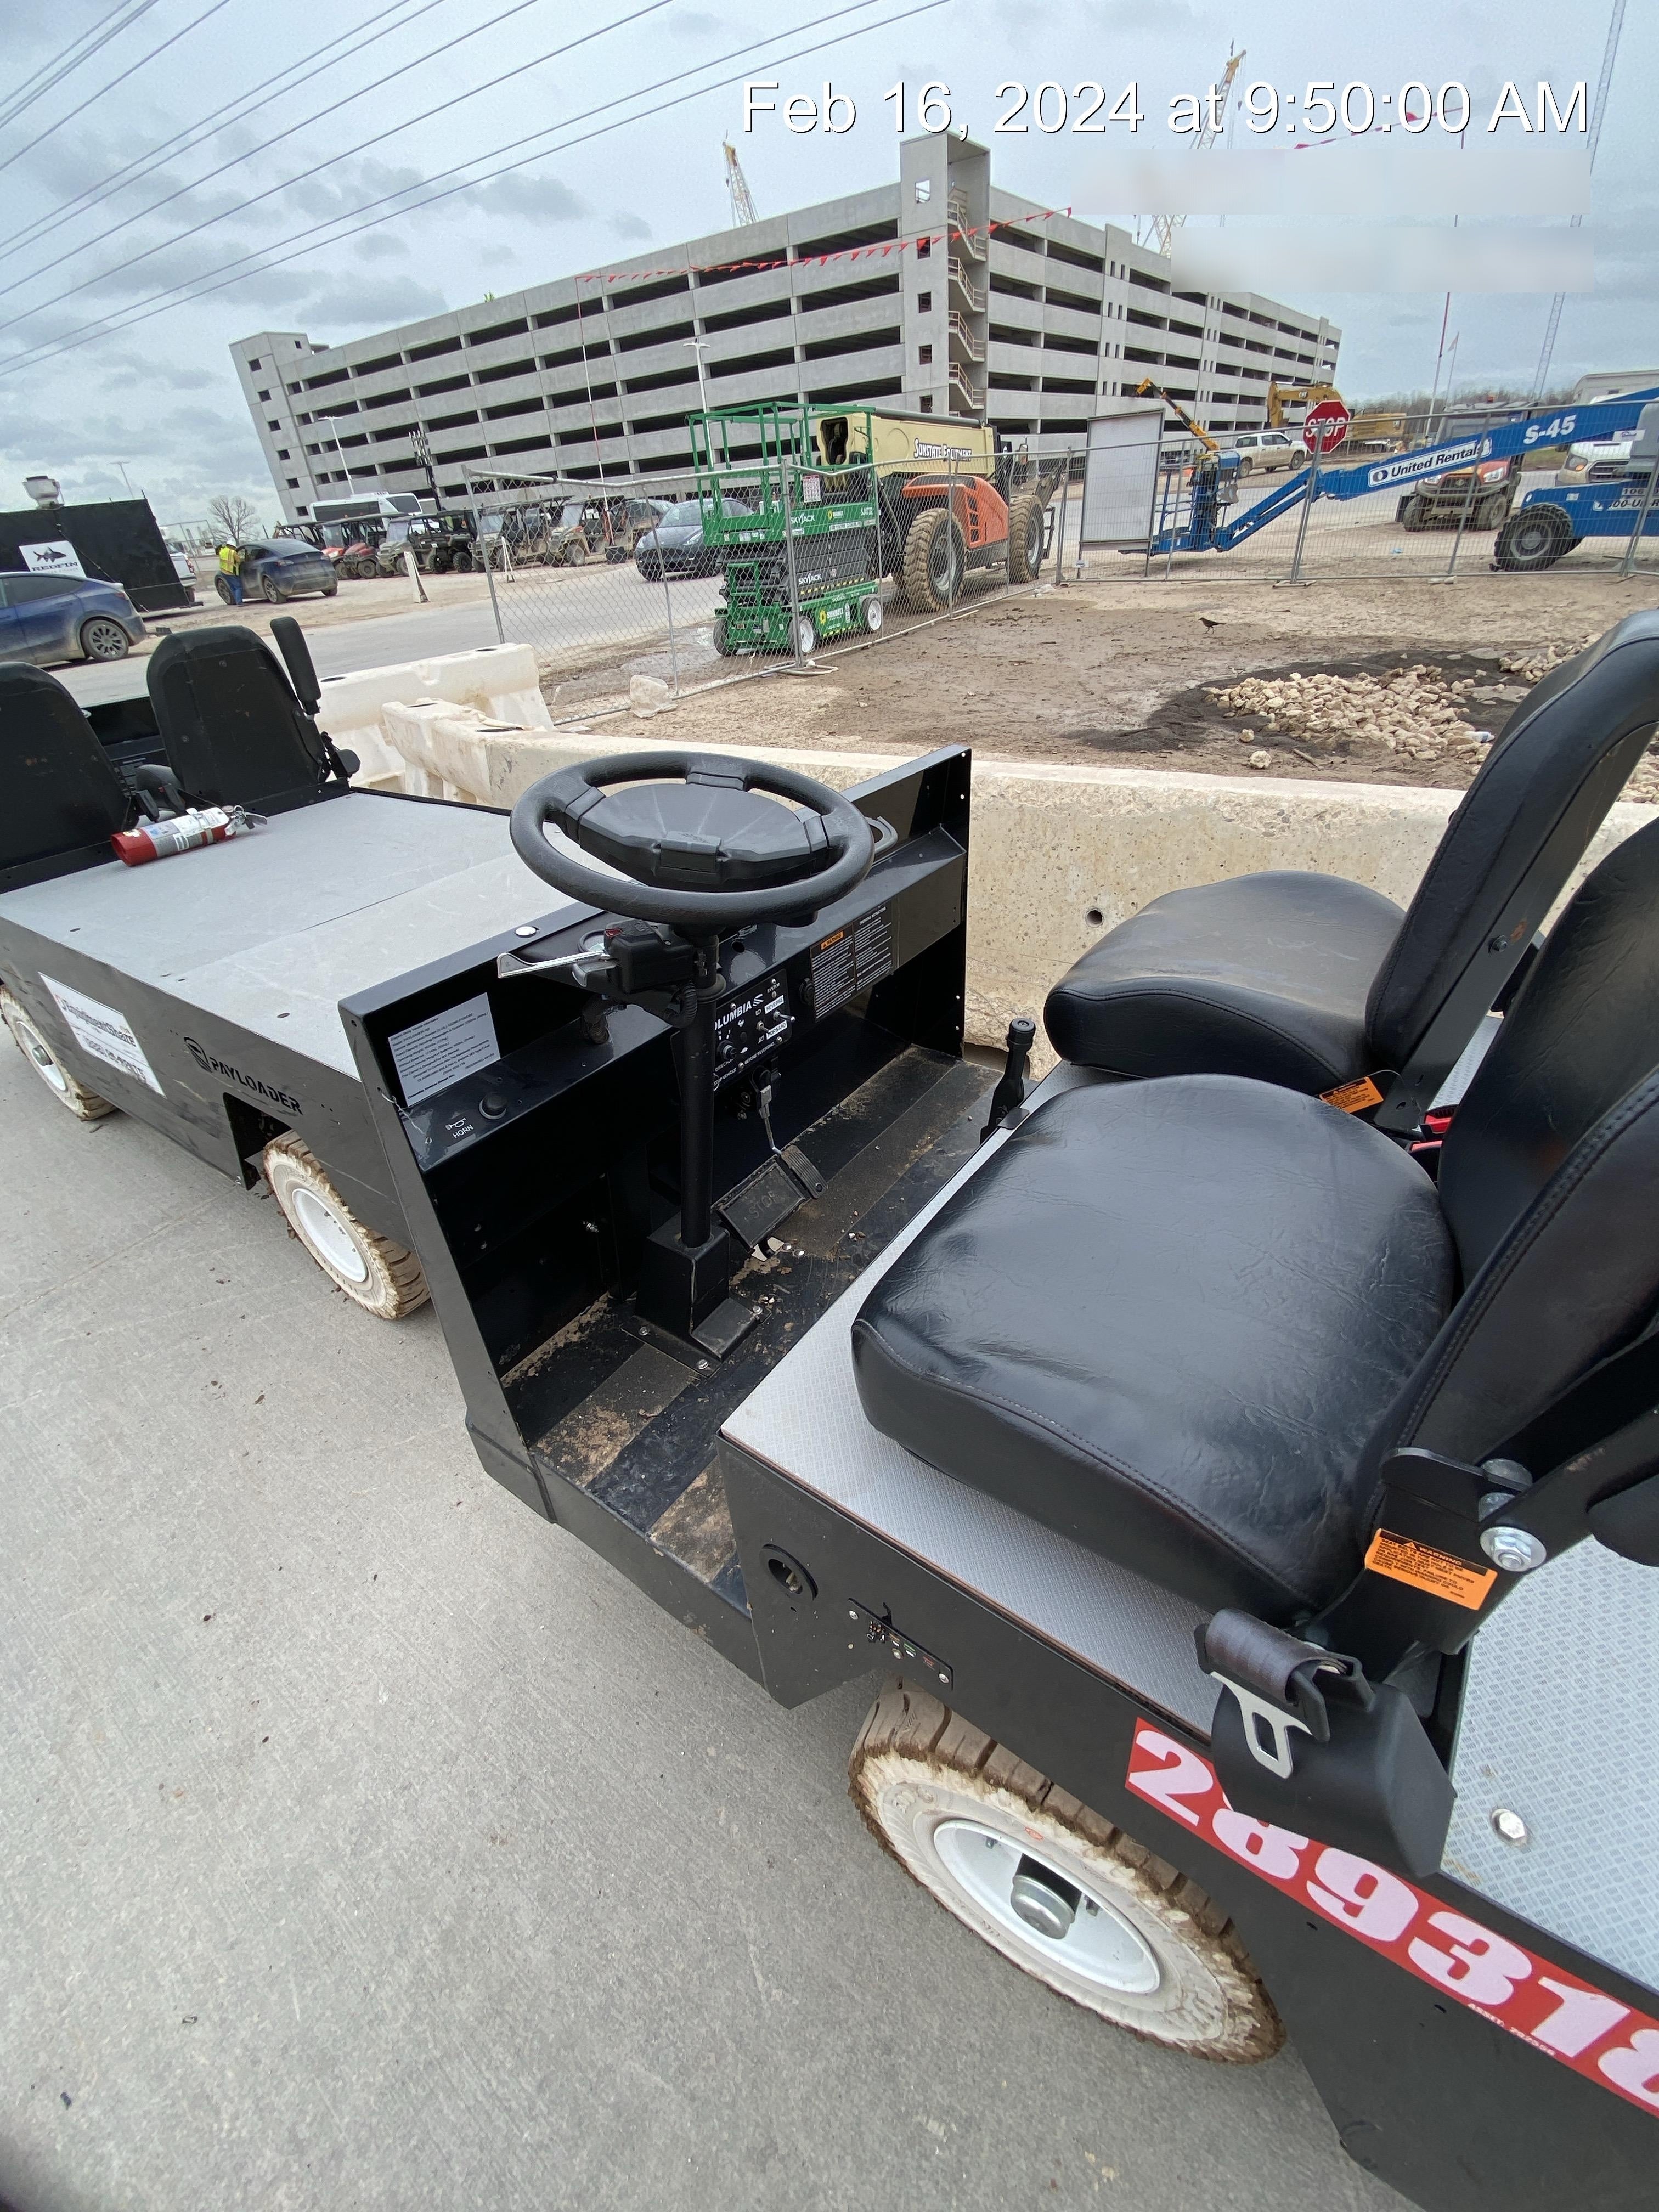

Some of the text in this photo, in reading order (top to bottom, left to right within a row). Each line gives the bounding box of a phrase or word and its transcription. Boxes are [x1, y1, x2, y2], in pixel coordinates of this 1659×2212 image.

[1523, 414, 1577, 444] S-45
[1391, 457, 1433, 478] United
[791, 512, 815, 524] SKYJACK
[31, 562, 78, 571] REDFIN
[798, 573, 822, 585] SKYJACK
[766, 997, 784, 1012] REVERSE
[714, 1000, 752, 1031] LUMBIA
[208, 1057, 303, 1115] PAYLOADER
[452, 1124, 475, 1139] HORN
[1418, 1546, 1463, 1566] WARNING
